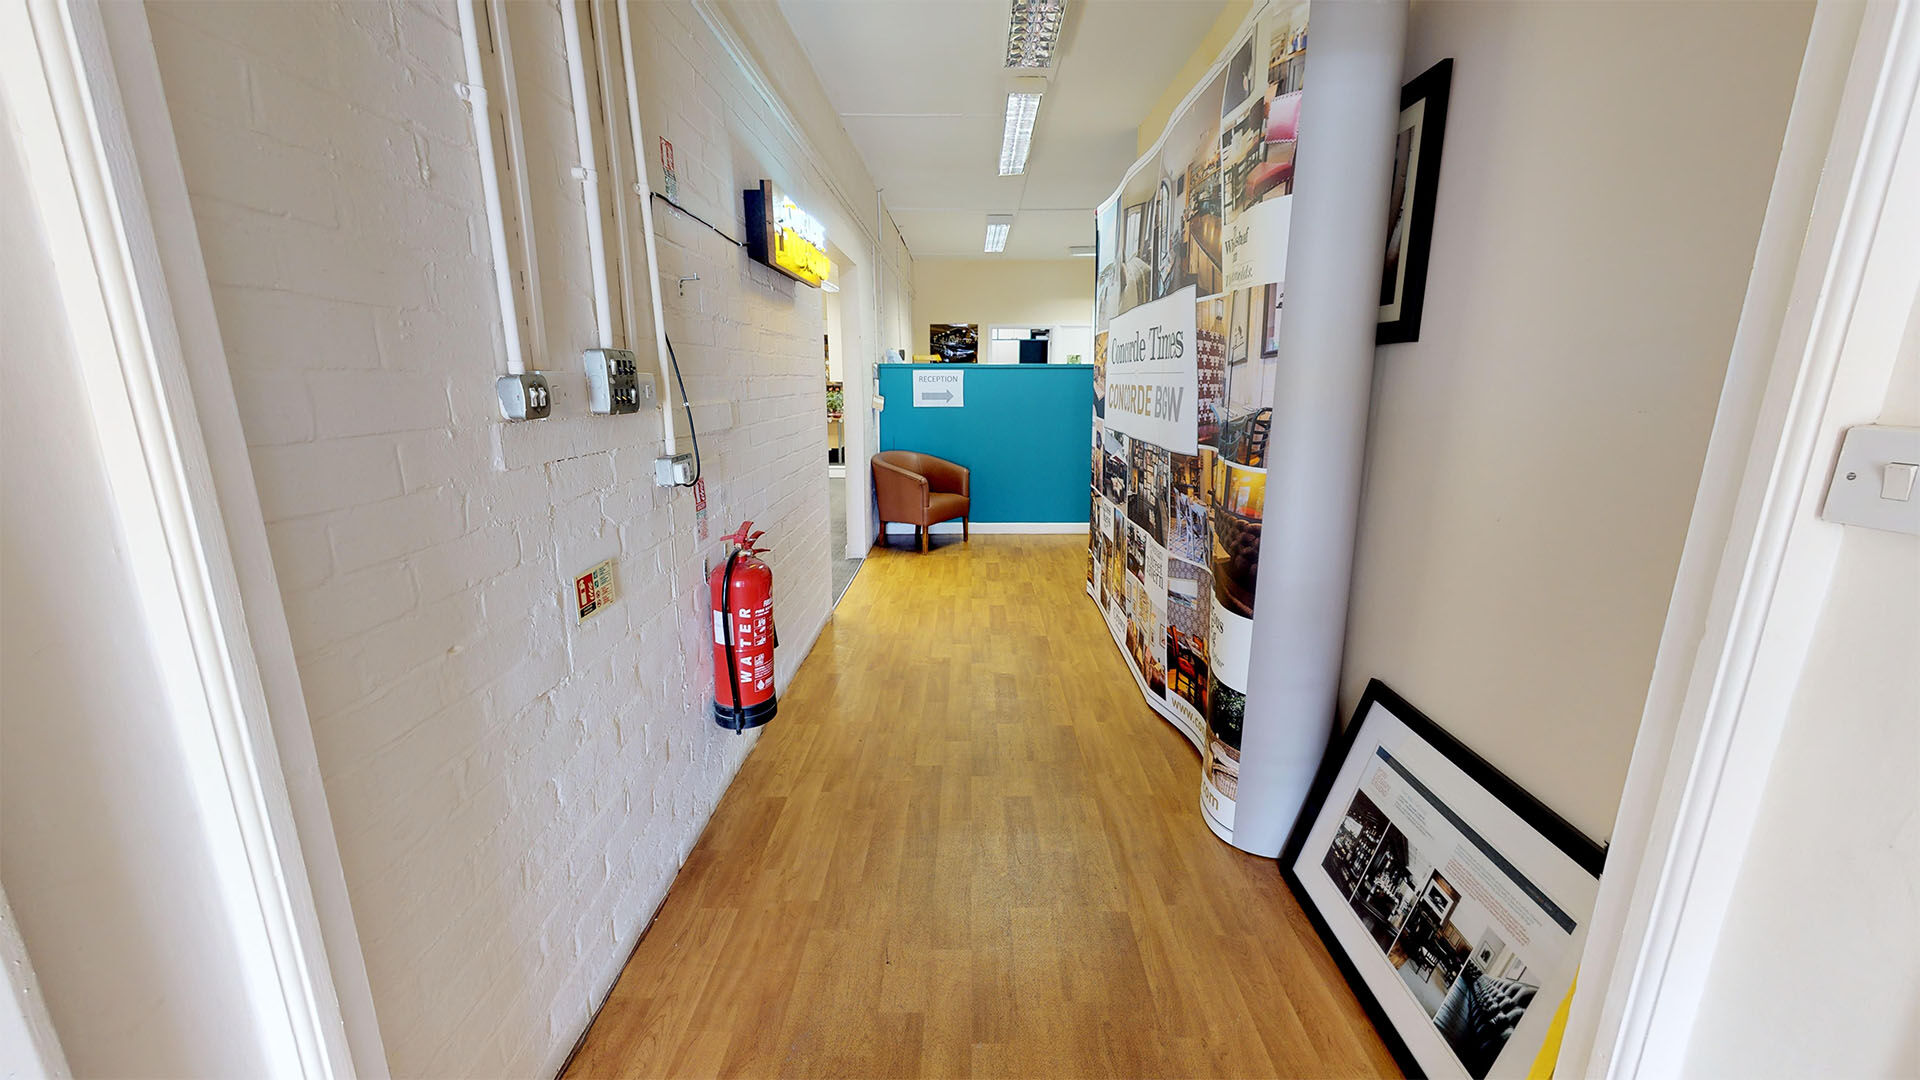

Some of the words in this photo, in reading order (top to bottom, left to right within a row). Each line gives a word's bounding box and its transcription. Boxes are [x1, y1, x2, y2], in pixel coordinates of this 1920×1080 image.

[1149, 325, 1184, 360] Times
[918, 375, 959, 383] RECEPTION
[1154, 385, 1184, 422] BGW
[739, 608, 752, 683] WATER
